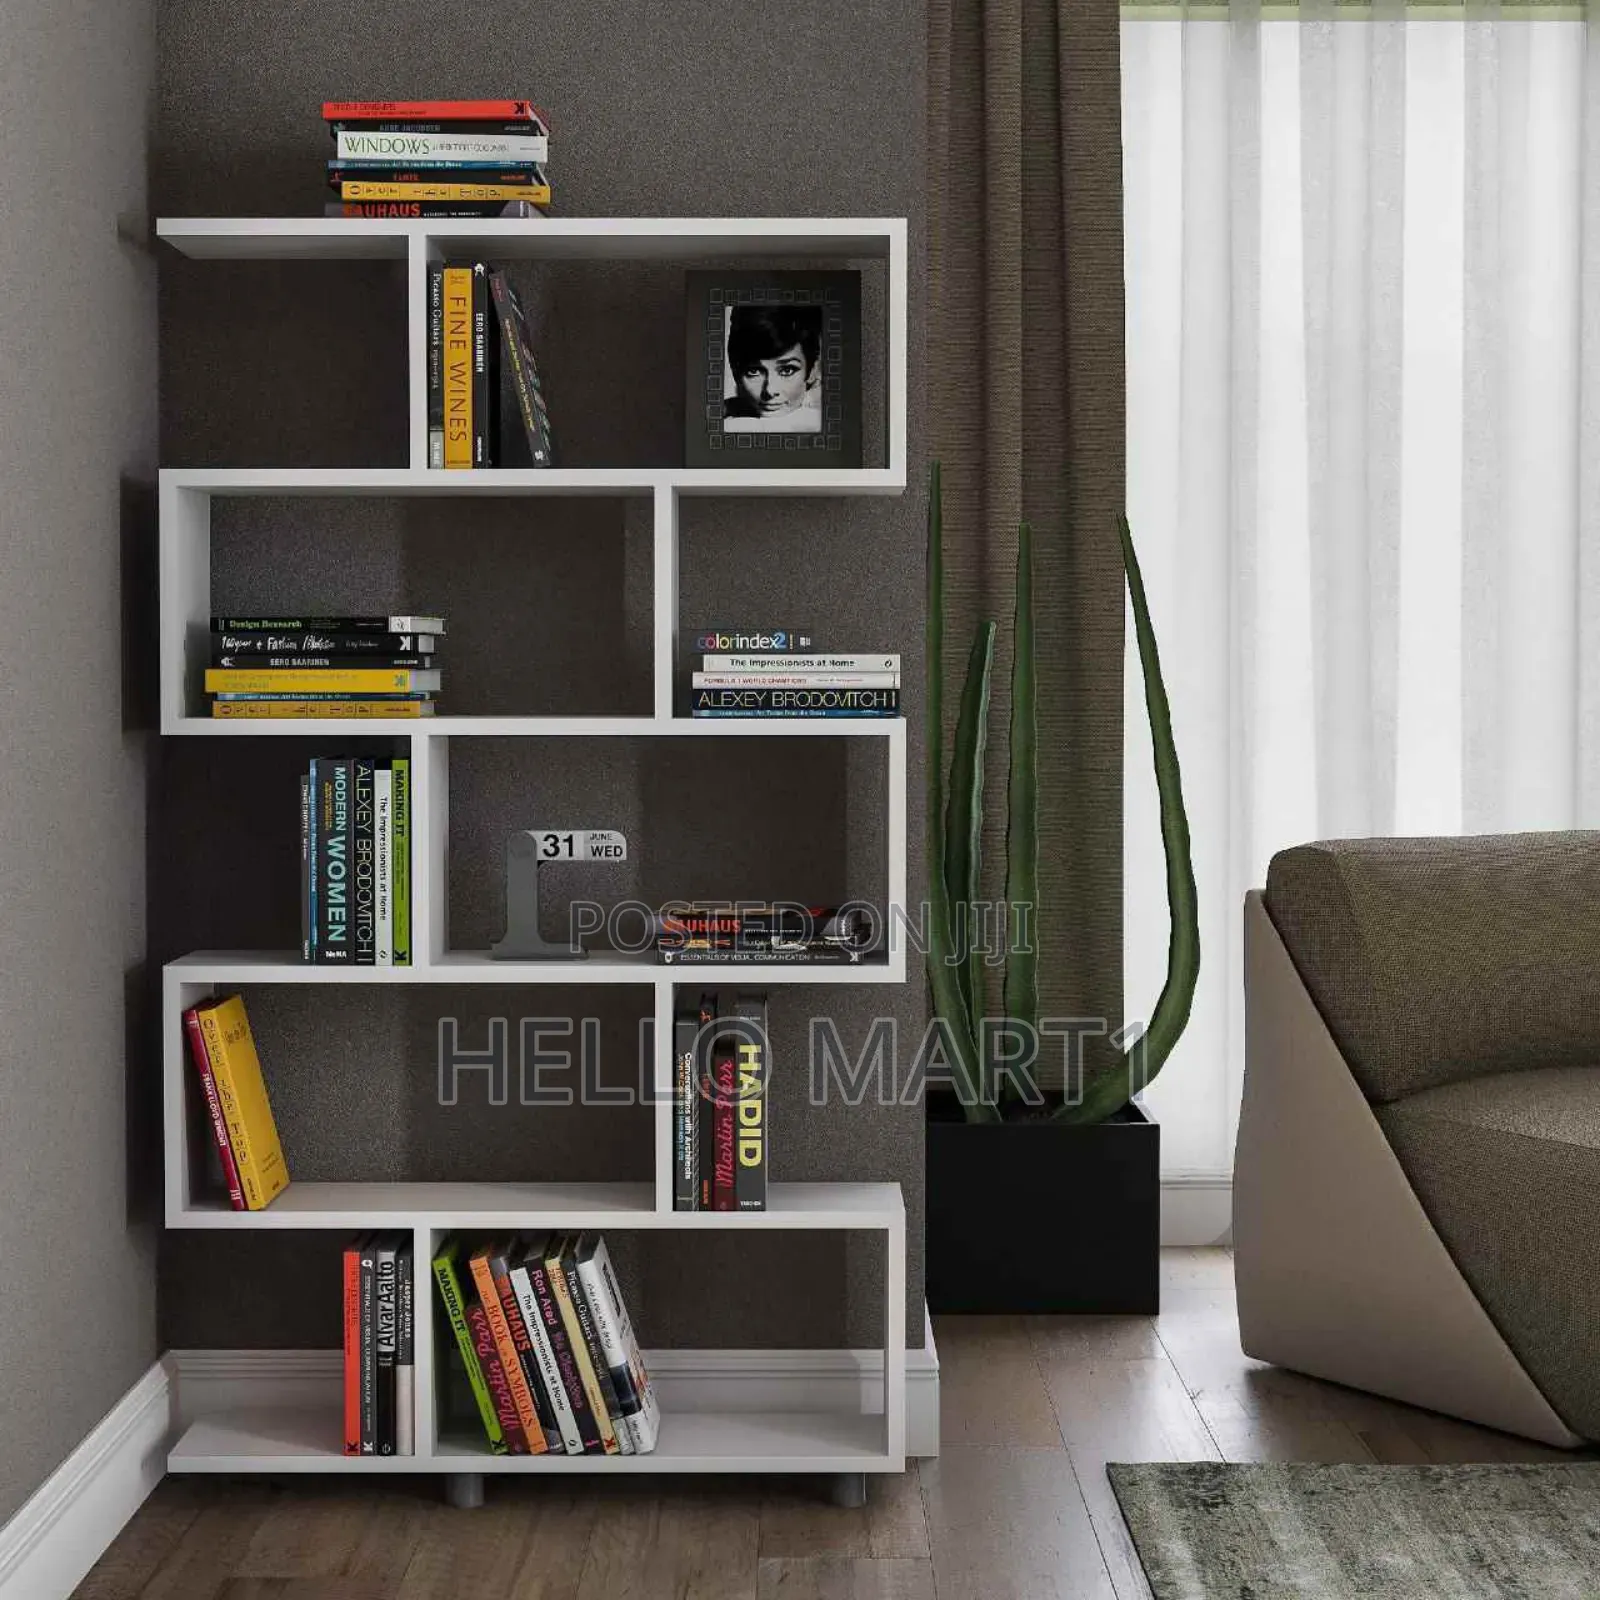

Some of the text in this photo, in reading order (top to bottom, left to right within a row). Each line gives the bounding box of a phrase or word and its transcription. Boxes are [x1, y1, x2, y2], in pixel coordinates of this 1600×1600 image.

[344, 136, 430, 155] WINDOWS
[449, 297, 466, 350] FINE
[449, 363, 467, 441] WINES
[697, 632, 788, 650] colorindex2
[729, 658, 855, 668] The Impressionists at Home
[698, 691, 887, 707] ALEXEY BRODOVITCH
[334, 767, 347, 831] MODERN
[379, 797, 388, 810] The
[395, 769, 405, 820] MAKING
[379, 811, 388, 881] Impressionists
[395, 822, 404, 837] IT
[542, 833, 574, 858] 31
[589, 833, 613, 841] JUNE
[590, 845, 623, 857] WED
[356, 765, 373, 953] ALEXEY BRODOVITCH
[327, 836, 347, 941] WOMEN
[664, 918, 741, 933] AUHAUS
[680, 953, 720, 961] ESSENTIALS
[754, 953, 810, 961] COMMUNICATION
[715, 1059, 735, 1188] Martin Parr
[739, 1044, 762, 1167] HADID
[377, 1260, 395, 1347] Alvar Aalto
[438, 1268, 466, 1332] MAKING IT
[531, 1269, 547, 1295] Ron
[523, 1294, 533, 1311] The
[528, 1310, 552, 1374] Impressionists
[470, 1307, 522, 1431] Martin Parr
[487, 1305, 508, 1341] BOOK
[506, 1358, 535, 1428] SYMBOLS
